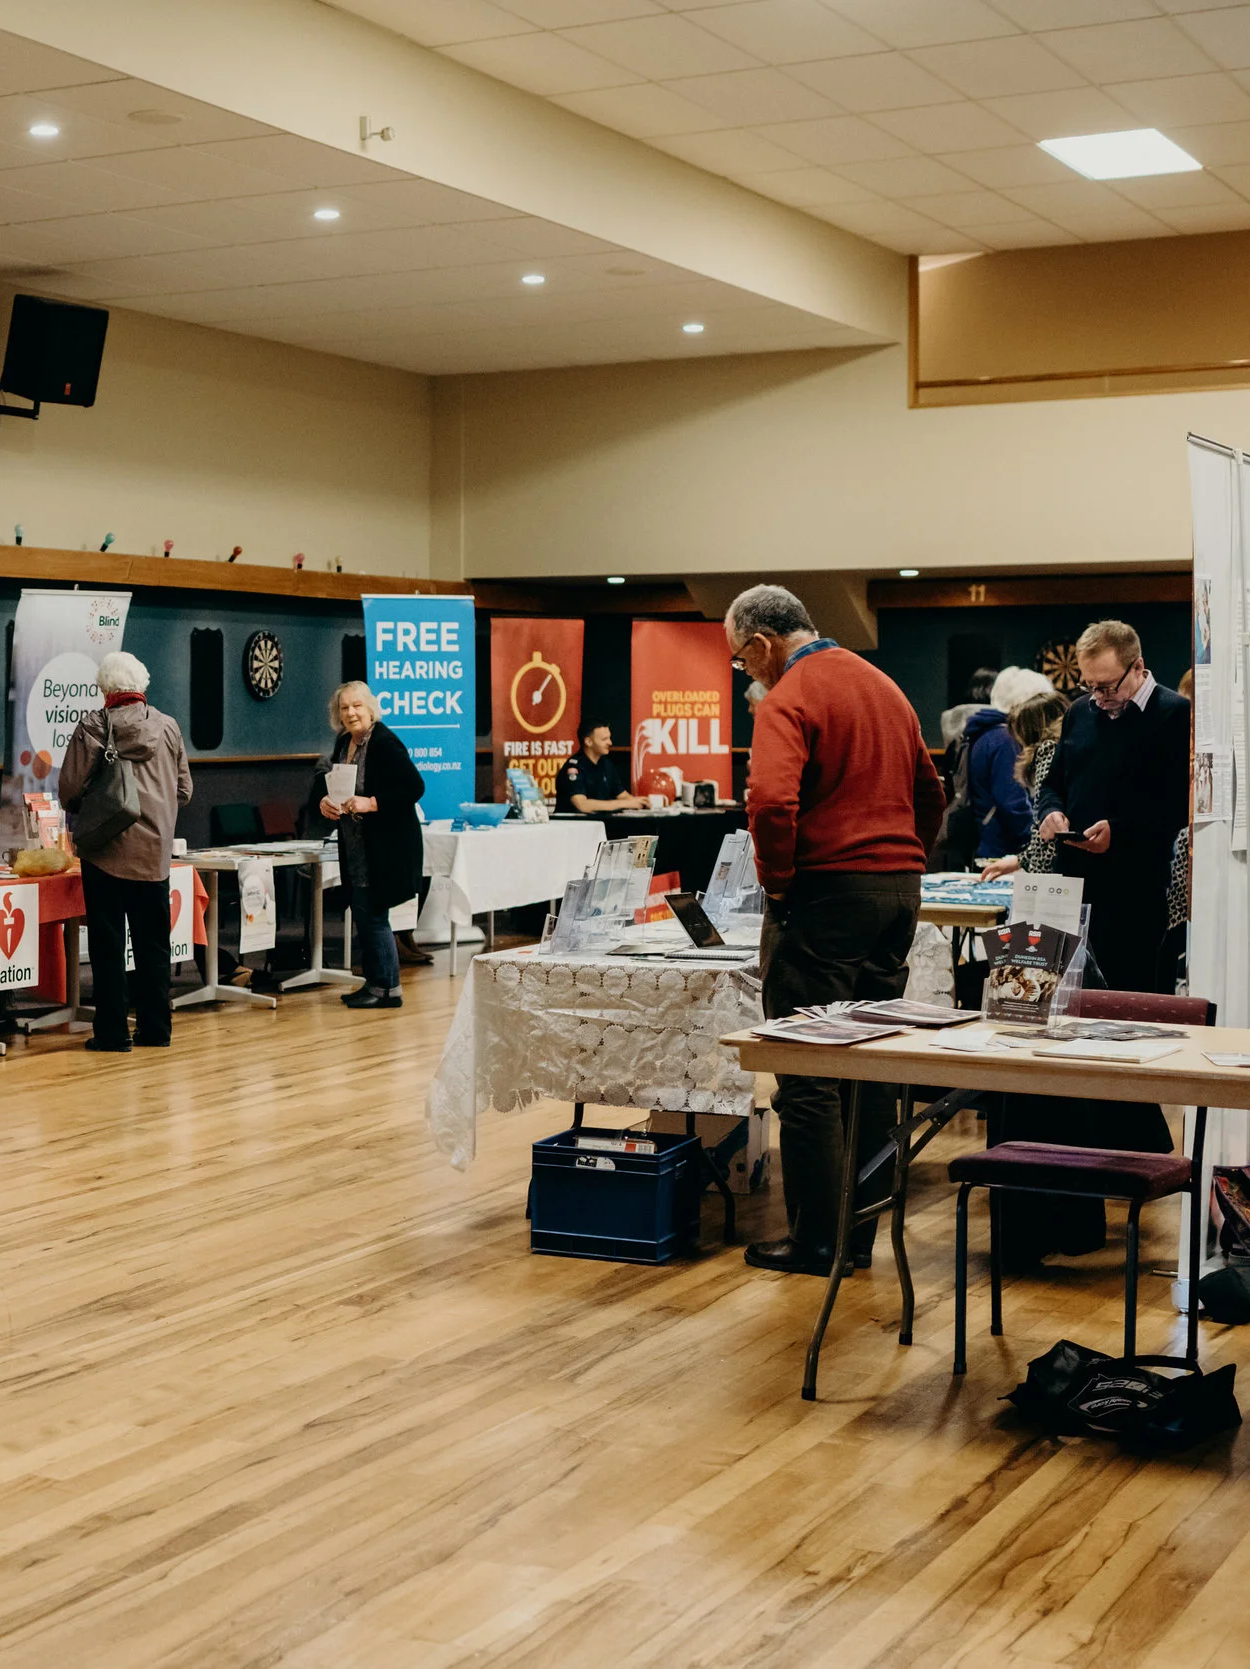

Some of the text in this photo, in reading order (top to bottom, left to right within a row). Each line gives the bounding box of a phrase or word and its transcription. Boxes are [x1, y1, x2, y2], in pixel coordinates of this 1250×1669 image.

[967, 584, 986, 602] 11
[375, 621, 460, 652] FREE
[375, 661, 463, 680] HEARING
[376, 691, 463, 716] CHECK
[652, 690, 720, 702] OVERLOADED
[652, 703, 720, 717] PLUGS CAN
[53, 729, 71, 749] los
[648, 718, 729, 754] KILL
[504, 740, 574, 757] FIRE IS FAST
[417, 761, 462, 773] diology.co.nz
